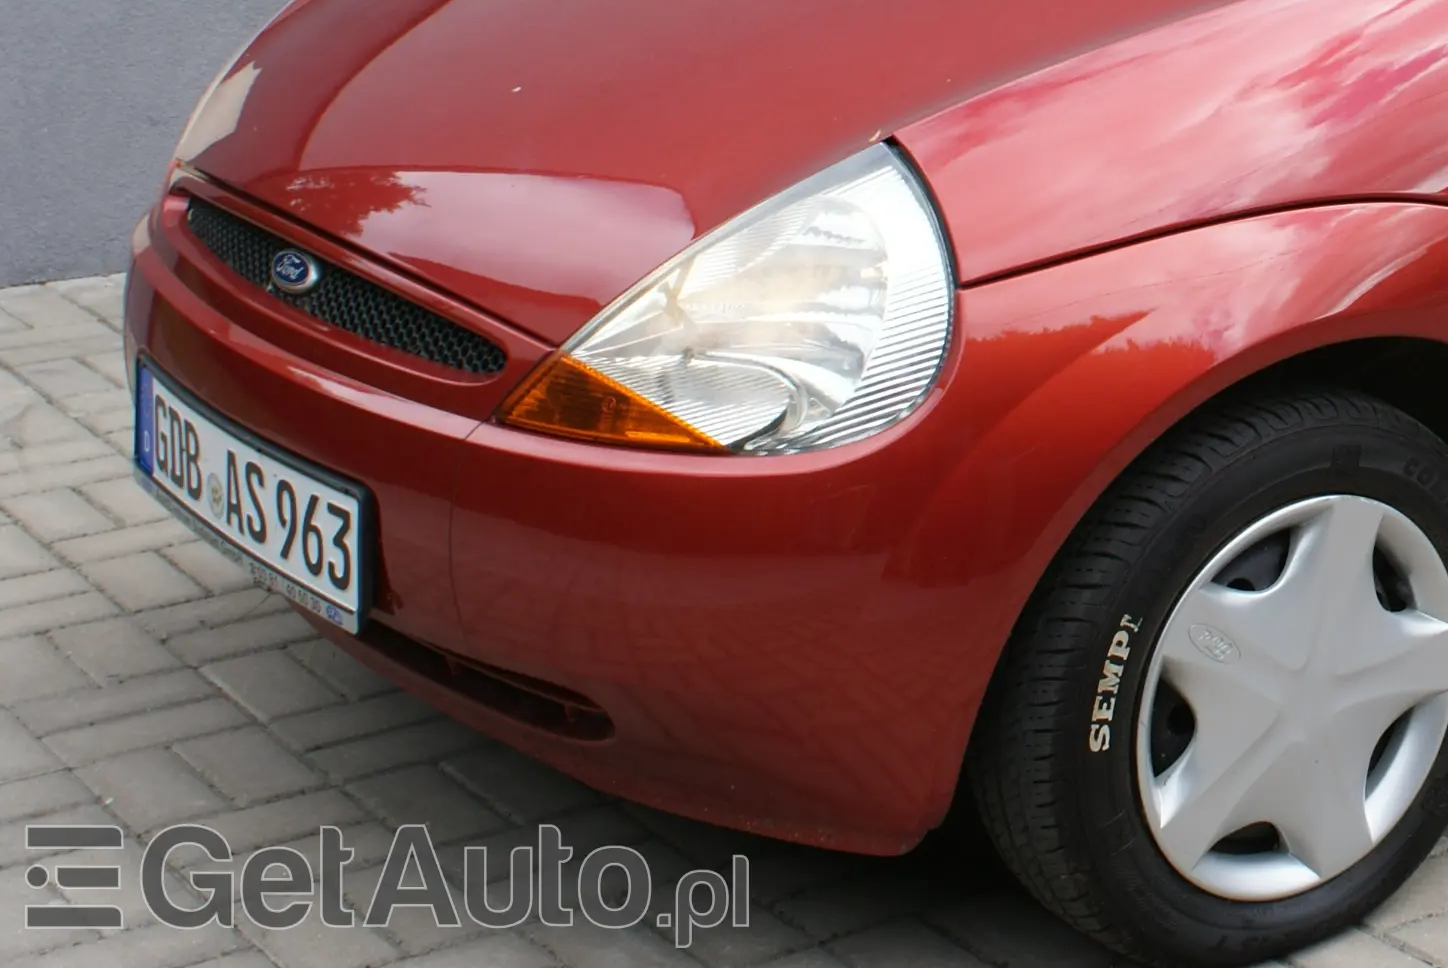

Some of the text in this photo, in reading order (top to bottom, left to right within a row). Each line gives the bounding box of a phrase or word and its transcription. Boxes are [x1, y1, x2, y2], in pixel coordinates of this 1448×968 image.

[154, 394, 202, 501] GDB
[226, 449, 267, 544] AS
[276, 479, 351, 591] 963
